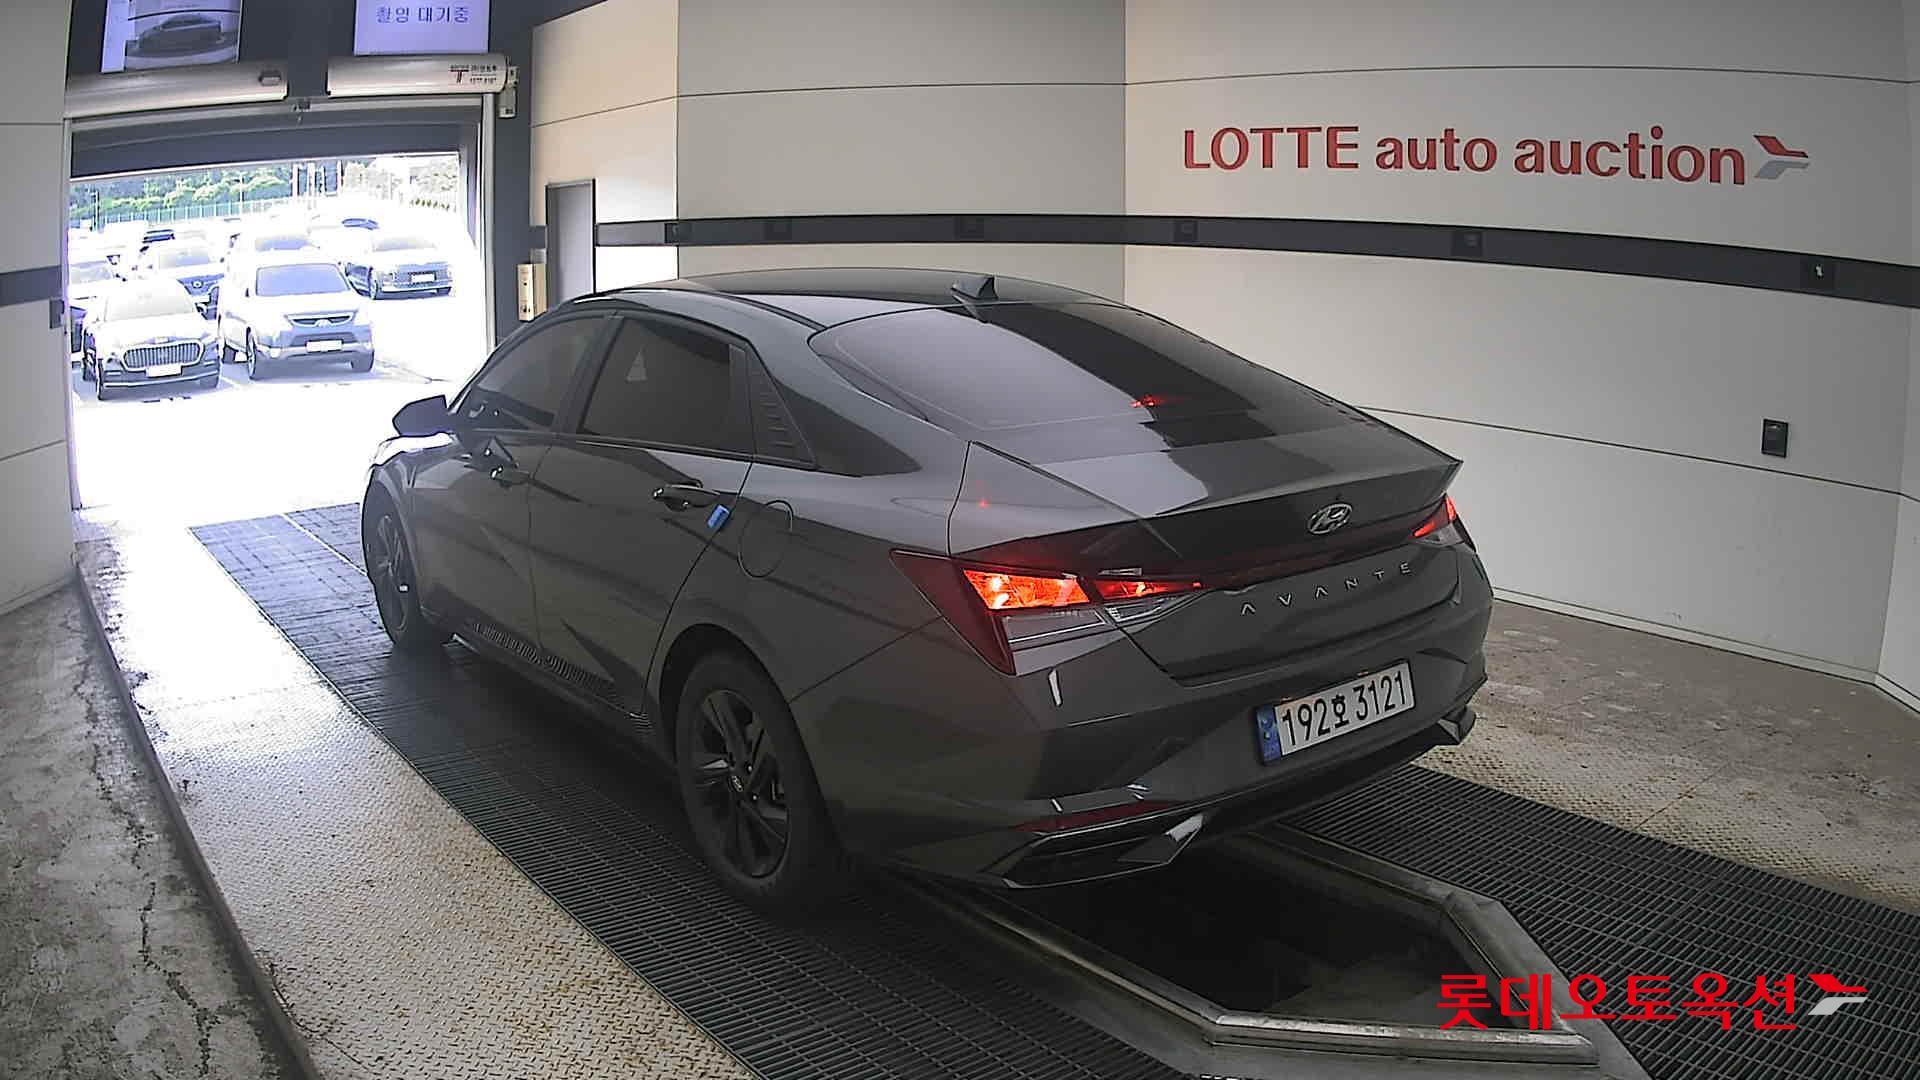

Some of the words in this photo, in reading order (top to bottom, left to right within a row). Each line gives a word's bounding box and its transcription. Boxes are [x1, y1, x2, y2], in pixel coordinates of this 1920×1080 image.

[418, 6, 469, 23] 대기중
[1184, 126, 1358, 170] LOTTE
[1375, 128, 1498, 172] auto
[1514, 126, 1745, 186] auction
[1241, 562, 1411, 616] AVANTE
[1353, 672, 1406, 720] 3121
